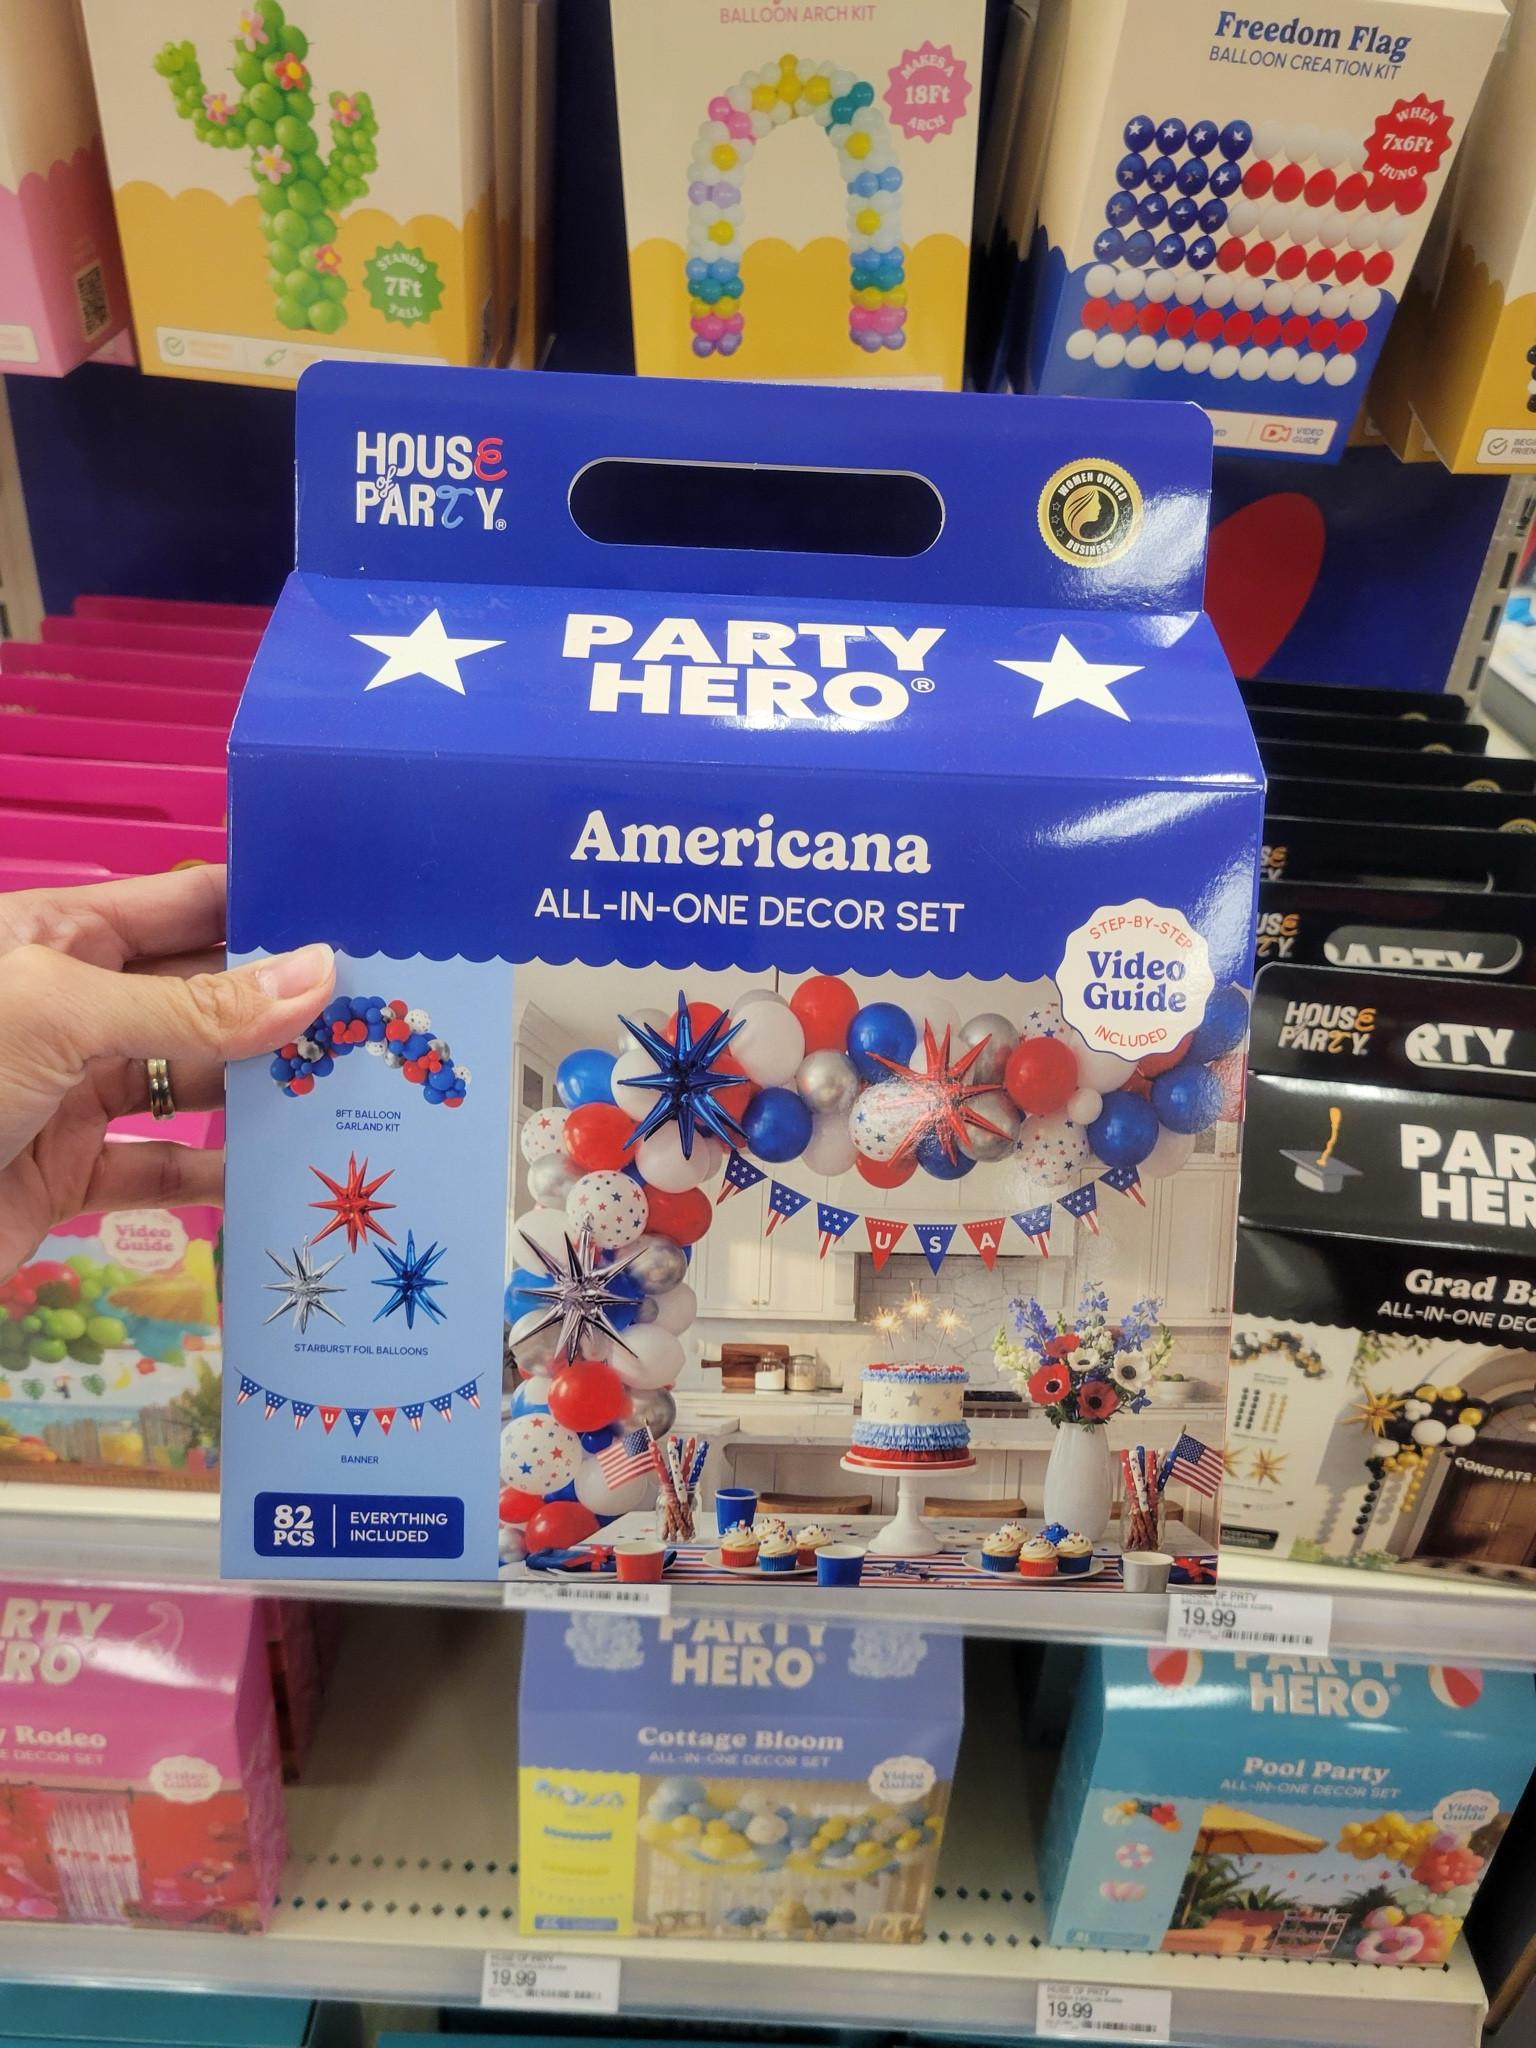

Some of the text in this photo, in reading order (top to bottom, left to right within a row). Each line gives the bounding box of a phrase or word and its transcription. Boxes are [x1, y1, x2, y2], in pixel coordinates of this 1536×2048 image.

[719, 5, 876, 24] BALLOON ARCH KIT
[1214, 10, 1412, 64] Freedom Flag
[901, 54, 955, 80] MAKES A
[1208, 45, 1402, 81] BALLOON CREATION KIT
[904, 84, 951, 105] 18Ft
[907, 114, 946, 131] ARCH
[1395, 106, 1438, 126] WHEN
[1381, 133, 1435, 154] 7x6Ft
[1378, 162, 1419, 181] HUNG
[376, 252, 428, 274] STANDS
[384, 276, 424, 298] 7Ft
[1291, 435, 1321, 446] GUIDE
[1296, 426, 1324, 437] VIDEO
[356, 431, 508, 482] HOUSE
[1057, 472, 1128, 502] WOMEN OWNED
[1065, 538, 1116, 556] BUSINESS
[562, 613, 947, 672] PARTY
[569, 809, 932, 874] Americana
[534, 887, 966, 933] ALL-IN-ONE DECOR SET
[1089, 915, 1193, 949] STEP-BY-STEP
[1087, 950, 1186, 981] Video
[1083, 982, 1187, 1012] Guide
[1283, 1000, 1377, 1033] HOUSE
[1094, 1024, 1168, 1048] INCLUDED
[336, 1110, 401, 1119] 8FT BALLOON
[336, 1122, 400, 1132] GARLAND KIT
[115, 1224, 172, 1238] Video
[115, 1238, 174, 1252] Guide
[1405, 1268, 1497, 1302] Grad
[1377, 1300, 1496, 1328] ALL-IN-ONE
[294, 1343, 429, 1356] STARBURST FOIL BALLOONS
[341, 1455, 379, 1464] BANNER
[1455, 1457, 1532, 1483] CONGRATS
[273, 1504, 314, 1530] 82
[350, 1511, 448, 1526] EVERYTHING
[273, 1530, 315, 1547] PCS
[350, 1529, 429, 1543] INCLUDED
[1183, 1606, 1236, 1628] 19.99
[15, 1724, 108, 1750] Rodeo
[637, 1726, 844, 1752] Cottage Bloom
[1243, 1756, 1391, 1787] Pool Party
[1220, 1778, 1401, 1800] ALL-IN-ONE DECOR SET
[492, 1969, 538, 1987] 19.99
[1048, 2001, 1093, 2018] 19.99
